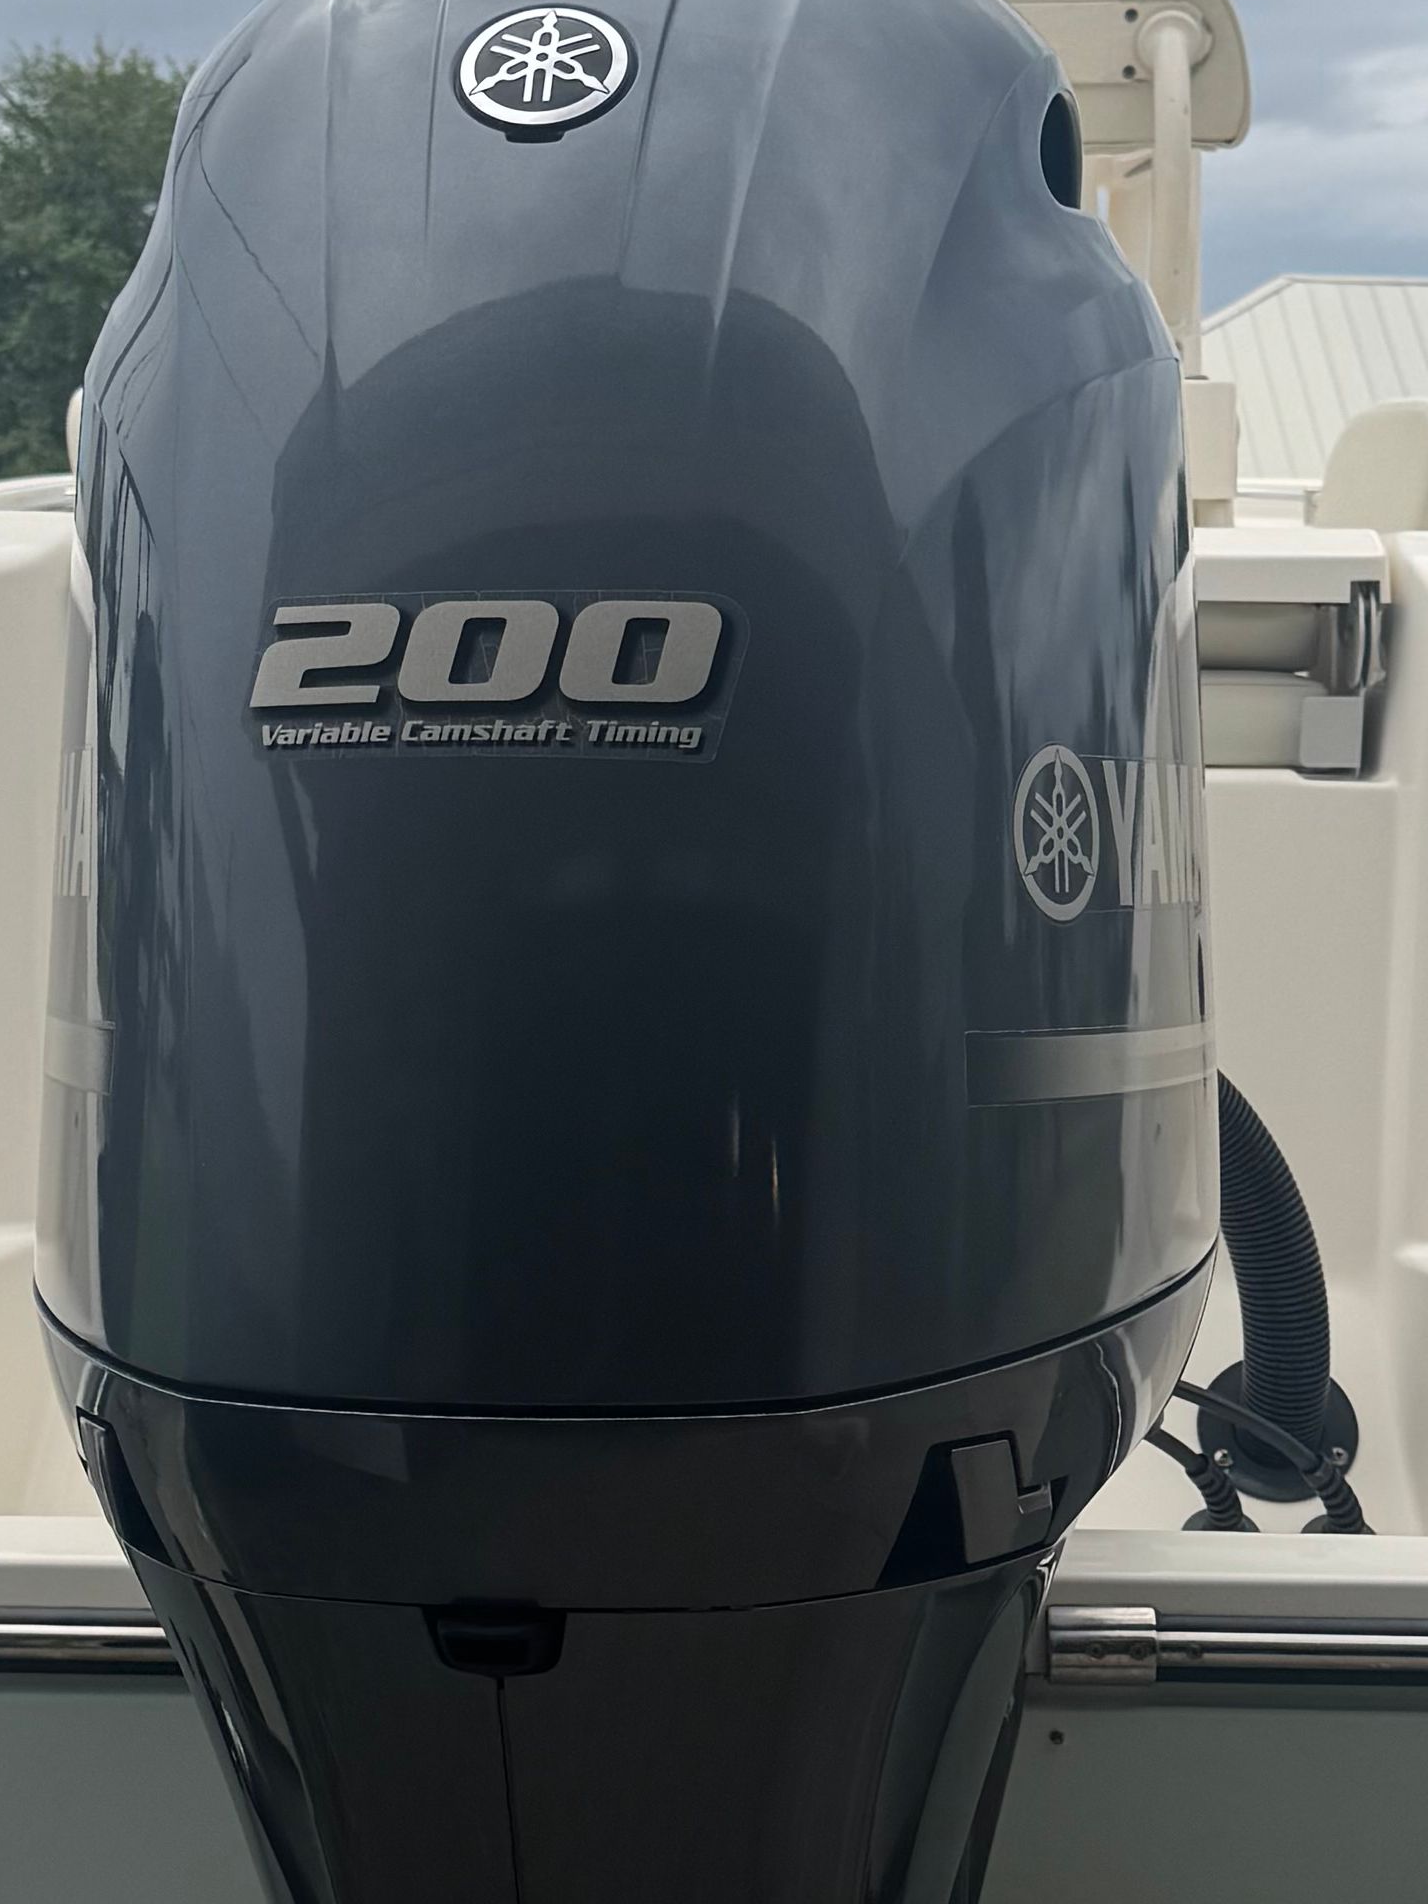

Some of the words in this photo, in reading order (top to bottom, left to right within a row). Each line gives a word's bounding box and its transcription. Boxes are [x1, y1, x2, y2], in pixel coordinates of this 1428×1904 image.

[249, 599, 723, 708] 200
[260, 720, 390, 747] Variable
[400, 718, 573, 743] Camshaft
[585, 718, 703, 749] Timing
